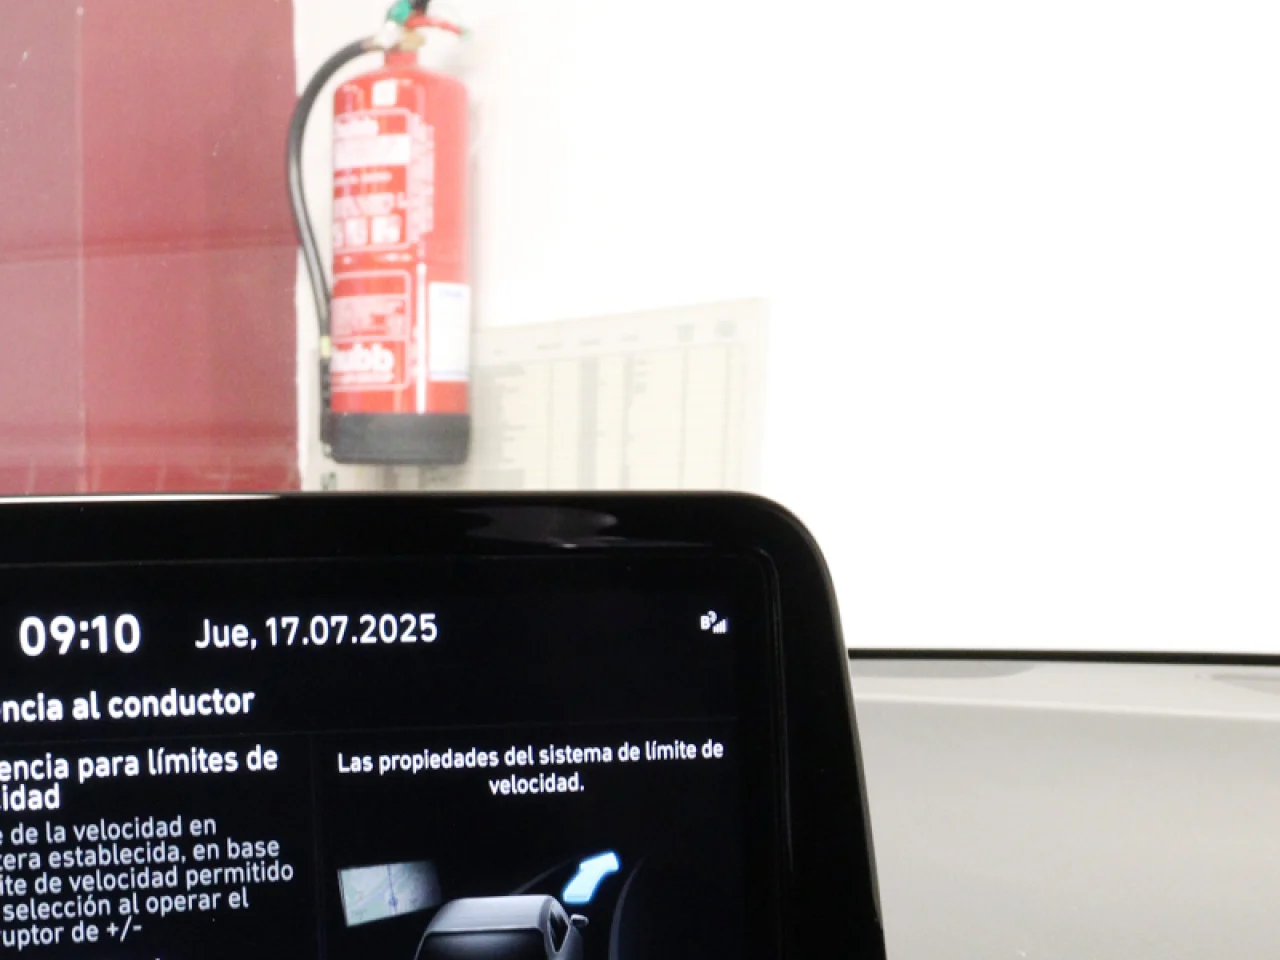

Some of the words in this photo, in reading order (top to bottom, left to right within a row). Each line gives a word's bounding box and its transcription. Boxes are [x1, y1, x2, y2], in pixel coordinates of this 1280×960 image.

[19, 614, 141, 656] 09:10
[195, 618, 257, 649] Jue,
[265, 613, 437, 646] 17.07.2025
[72, 691, 100, 720] al
[108, 688, 255, 718] conductor
[78, 753, 139, 783] para
[148, 748, 238, 775] límites
[247, 745, 277, 771] de
[338, 752, 373, 773] Las
[379, 749, 499, 775] propiedades
[505, 746, 534, 766] del
[539, 742, 613, 765] sistema
[618, 741, 640, 761] de
[646, 739, 696, 760] límite
[702, 739, 723, 758] de
[489, 771, 584, 794] velocidad.
[11, 823, 38, 844] de
[46, 822, 66, 843] la
[73, 816, 181, 841] velocidad
[190, 818, 216, 837] en
[49, 842, 185, 867] establecida,
[193, 842, 219, 861] en
[227, 837, 279, 859] base
[35, 873, 61, 894] de
[69, 866, 177, 892] velocidad
[186, 862, 293, 889] permitido
[3, 894, 110, 920] selección
[120, 896, 139, 915] al
[146, 892, 220, 916] operar
[228, 888, 248, 908] el
[71, 921, 98, 941] de
[106, 917, 142, 941] +/-
